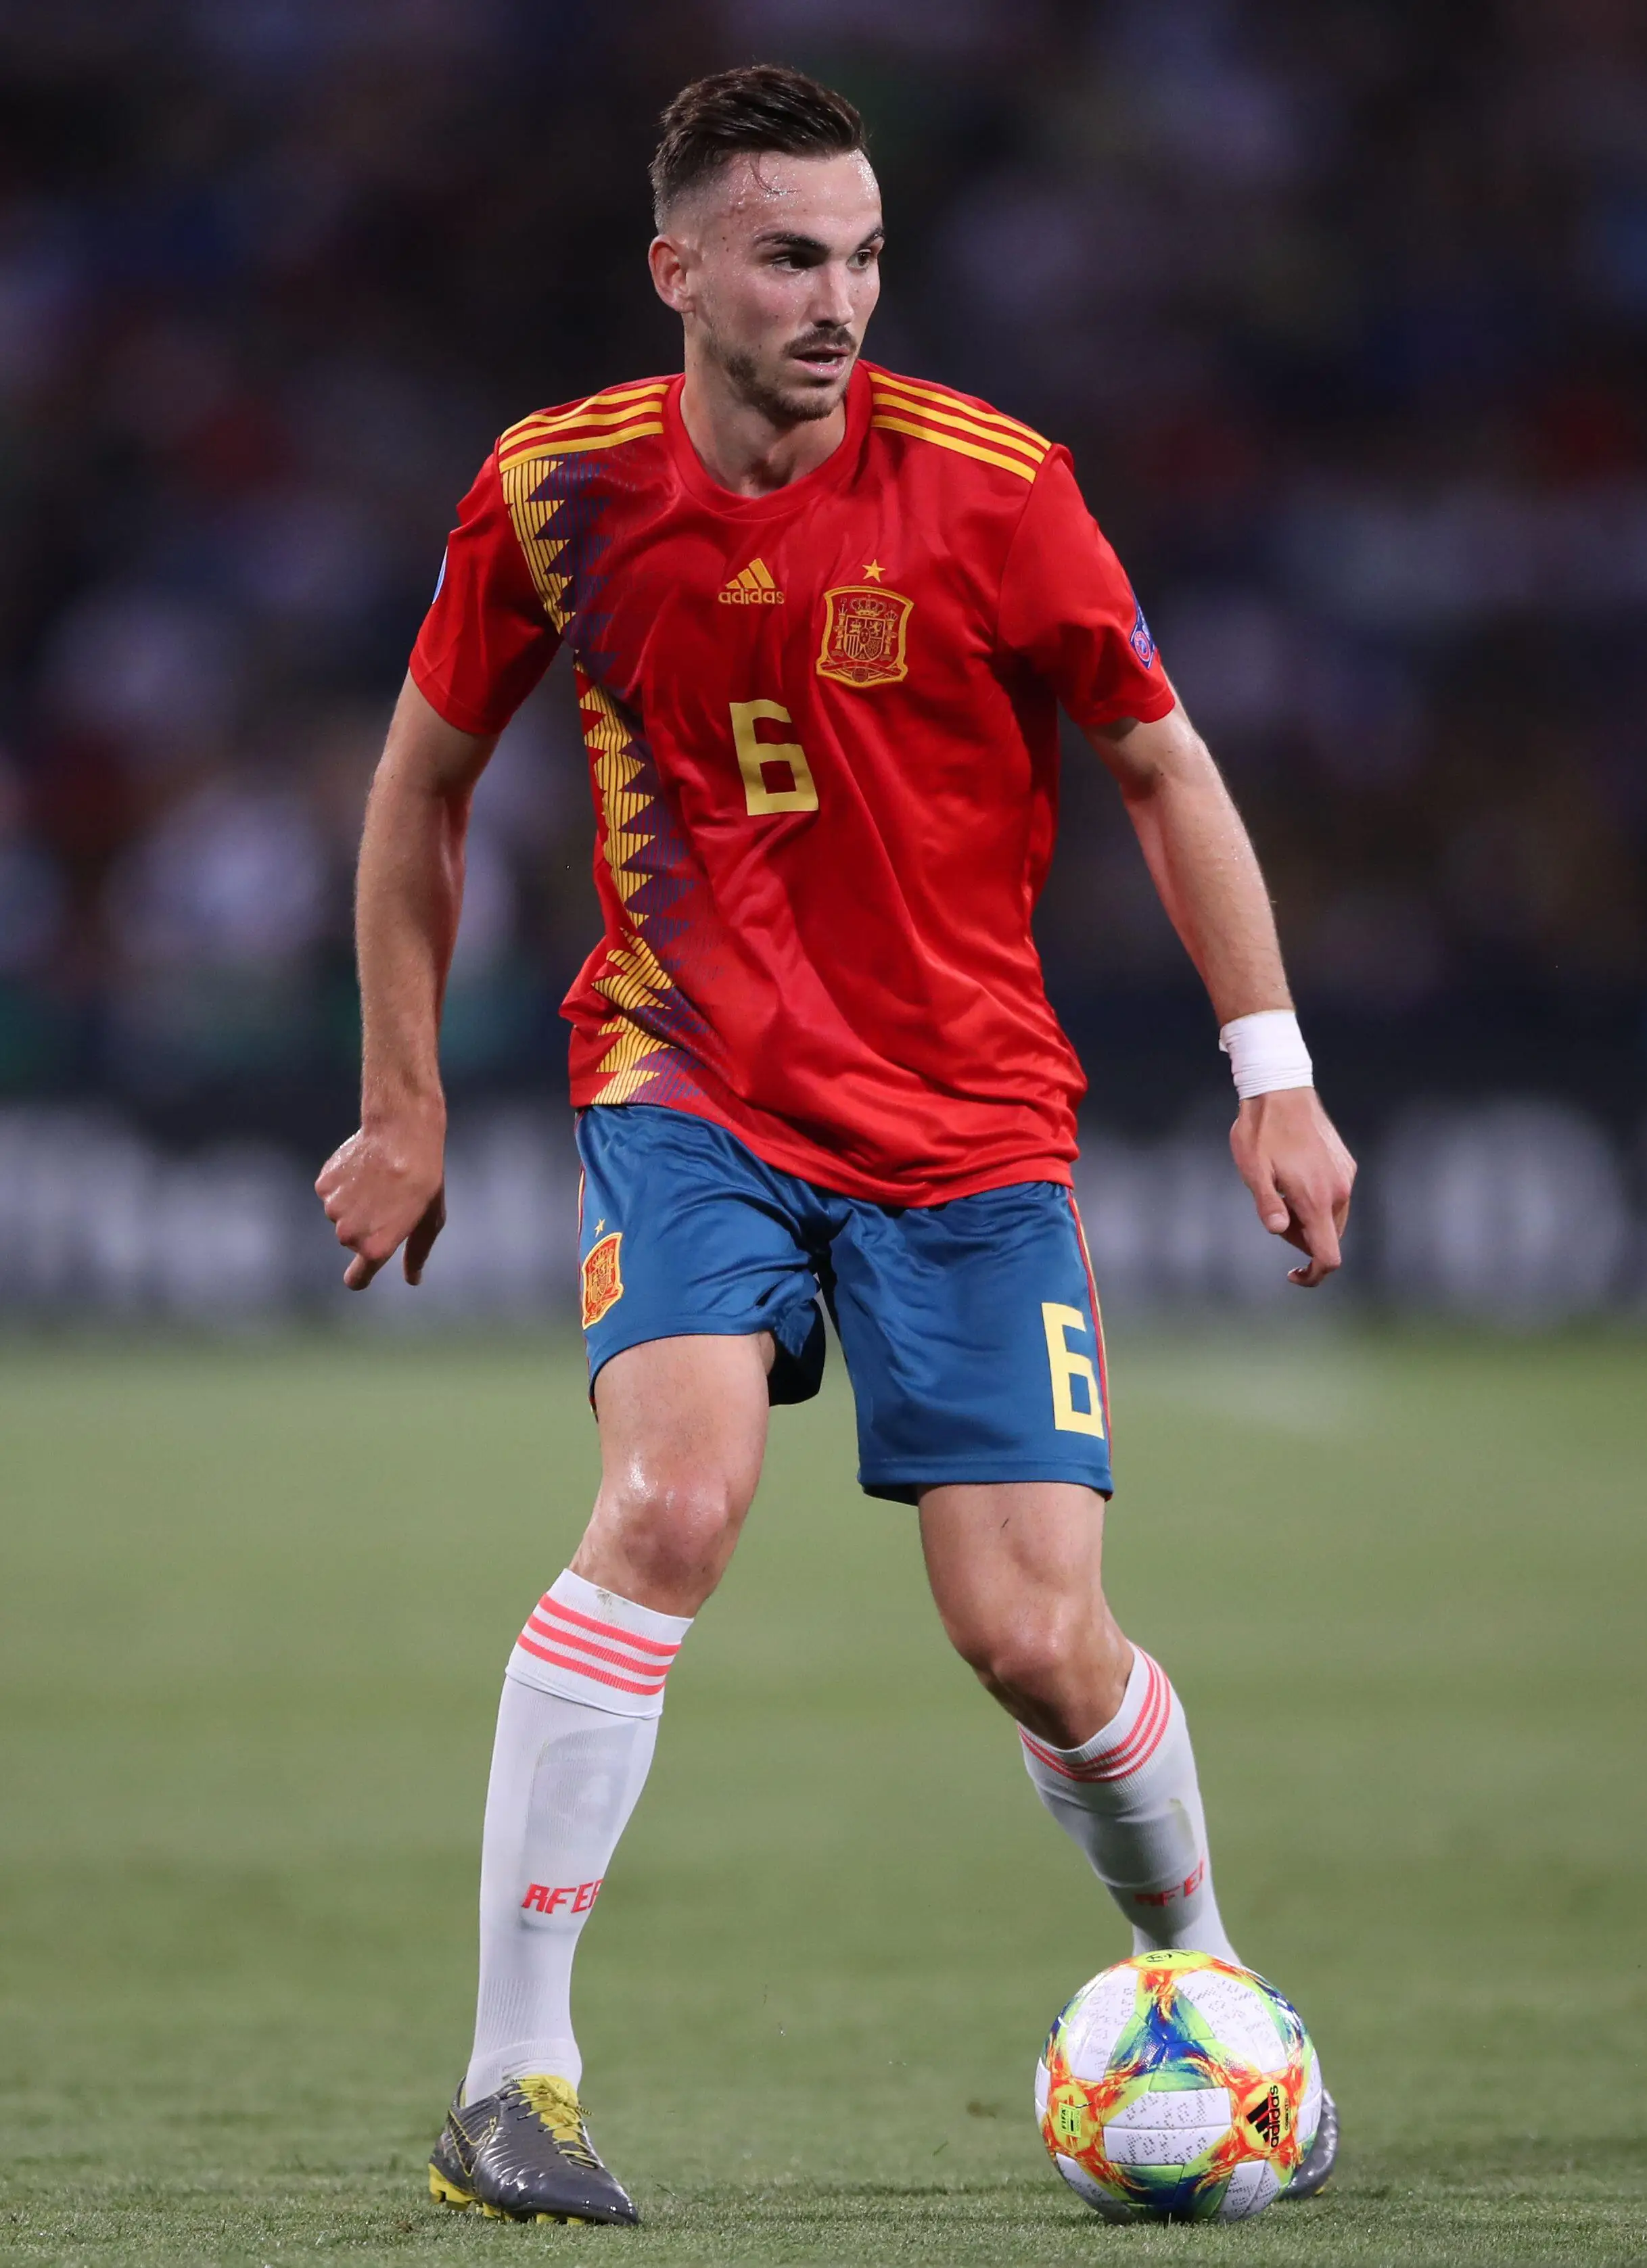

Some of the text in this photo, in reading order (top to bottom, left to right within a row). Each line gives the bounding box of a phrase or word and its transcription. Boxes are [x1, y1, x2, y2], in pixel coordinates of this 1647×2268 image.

[718, 587, 785, 605] adidas
[728, 699, 819, 816] 6
[1041, 1302, 1105, 1440] 6
[1268, 2085, 1280, 2148] adidas
